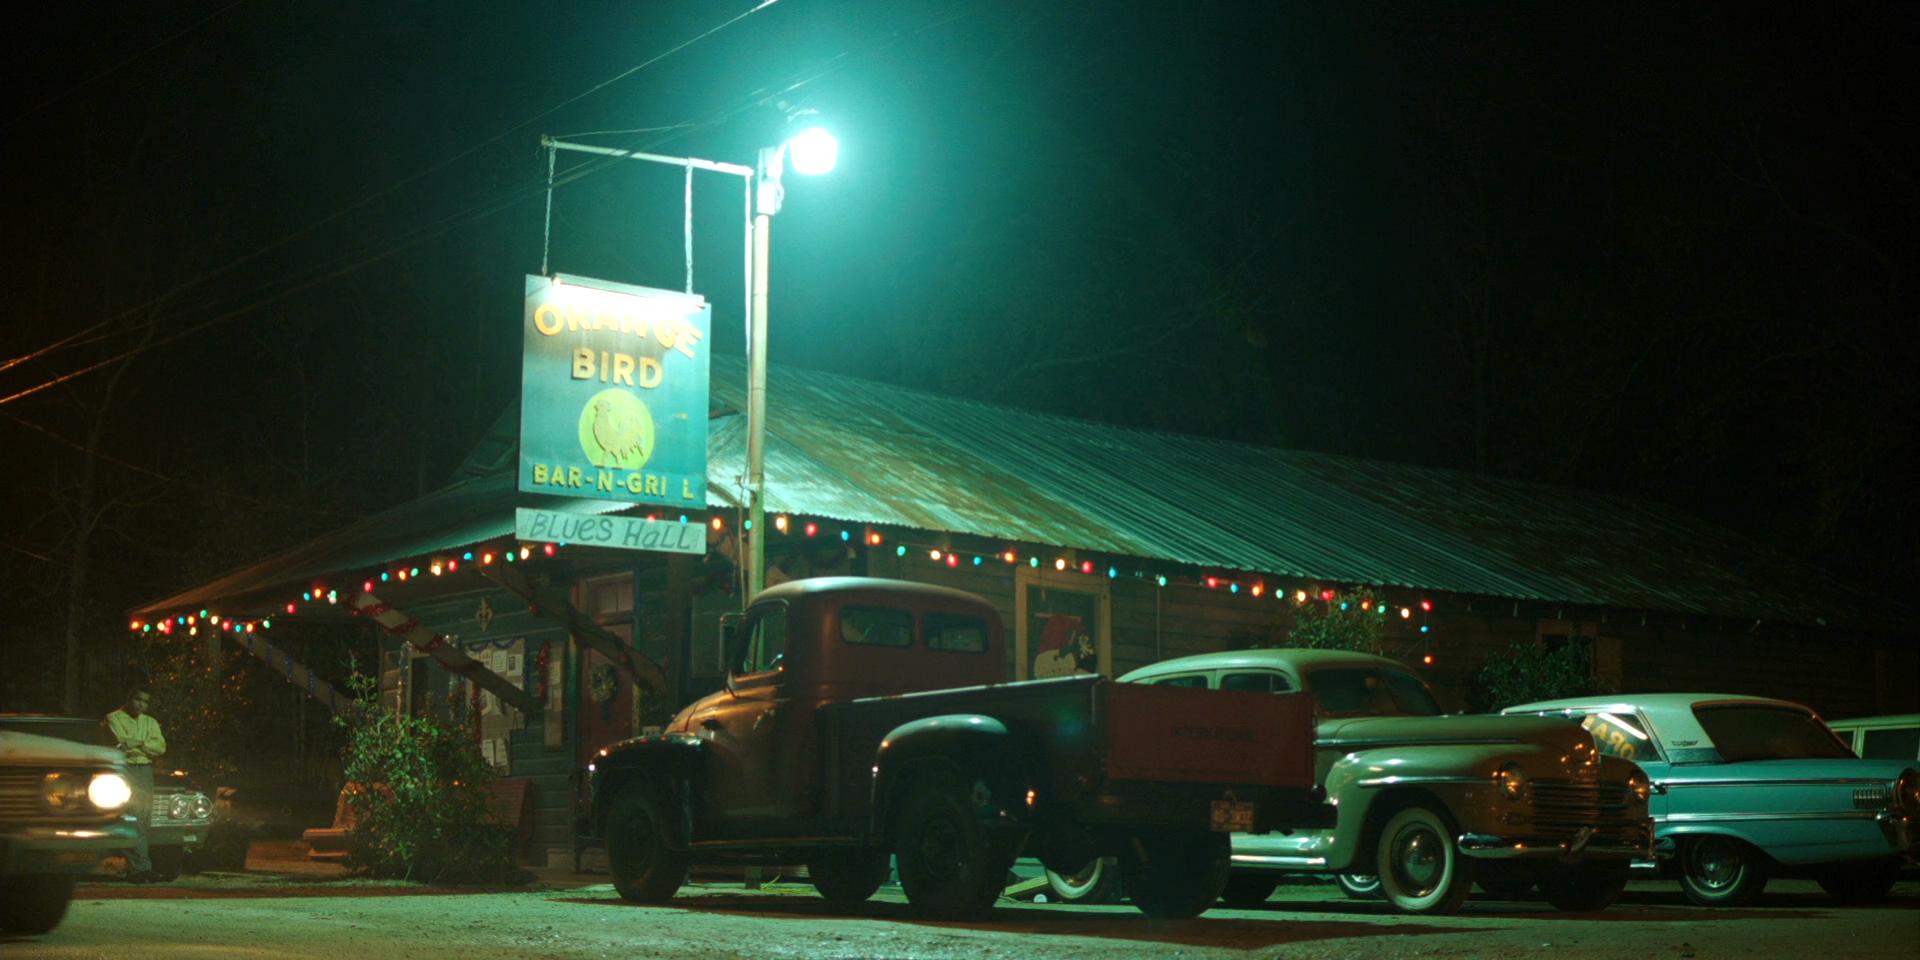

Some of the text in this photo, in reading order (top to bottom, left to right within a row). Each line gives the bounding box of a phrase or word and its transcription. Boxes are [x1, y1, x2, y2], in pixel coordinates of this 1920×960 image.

[533, 302, 702, 359] ORANGE
[571, 347, 663, 389] BIRD
[532, 463, 695, 499] BAR-N-GRIL
